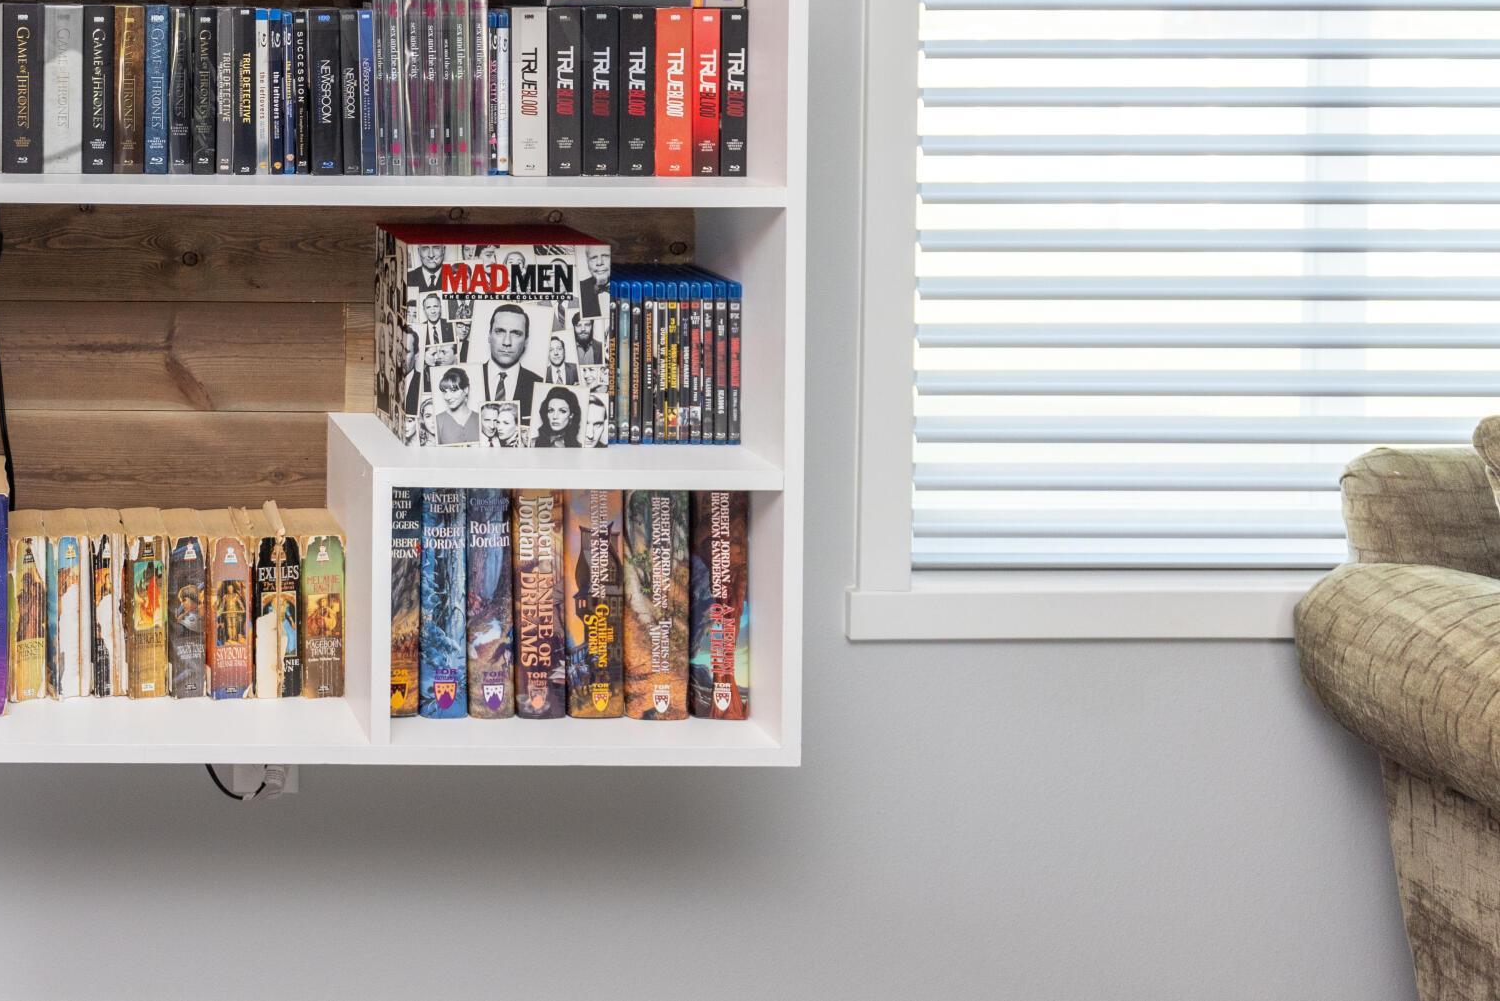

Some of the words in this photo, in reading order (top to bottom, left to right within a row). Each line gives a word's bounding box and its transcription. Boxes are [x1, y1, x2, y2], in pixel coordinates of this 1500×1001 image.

[16, 27, 30, 65] GAME
[93, 29, 105, 65] GAME
[222, 52, 231, 77] TRUE
[321, 60, 332, 124] NEWSROOM
[346, 68, 355, 119] NEWSROOM
[363, 58, 371, 96] NEWSROOM
[16, 72, 29, 128] THRONES
[92, 74, 105, 129] THRONES
[222, 78, 231, 122] DETECTIVE
[395, 491, 410, 499] THE
[430, 504, 460, 513] HEART
[711, 492, 720, 537] BRANDON
[720, 492, 729, 536] ROBERT
[424, 527, 465, 537] ROBERT
[470, 521, 510, 534] Robert
[470, 535, 510, 547] Jordan
[519, 496, 536, 560] Jordan
[538, 497, 554, 560] Robert
[652, 497, 660, 544] BRANDON
[660, 497, 670, 542] ROBERT
[424, 538, 466, 548] JORDAN
[600, 538, 608, 581] JORDAN
[721, 540, 730, 583] JORDAN
[591, 541, 599, 597] SANDERSON
[652, 548, 661, 607] SANDERSON
[661, 546, 670, 590] JORDAN
[521, 573, 537, 667] DREAMS
[584, 615, 598, 655] STORM
[596, 604, 609, 667] GATHERING
[659, 618, 672, 658] TOWERS
